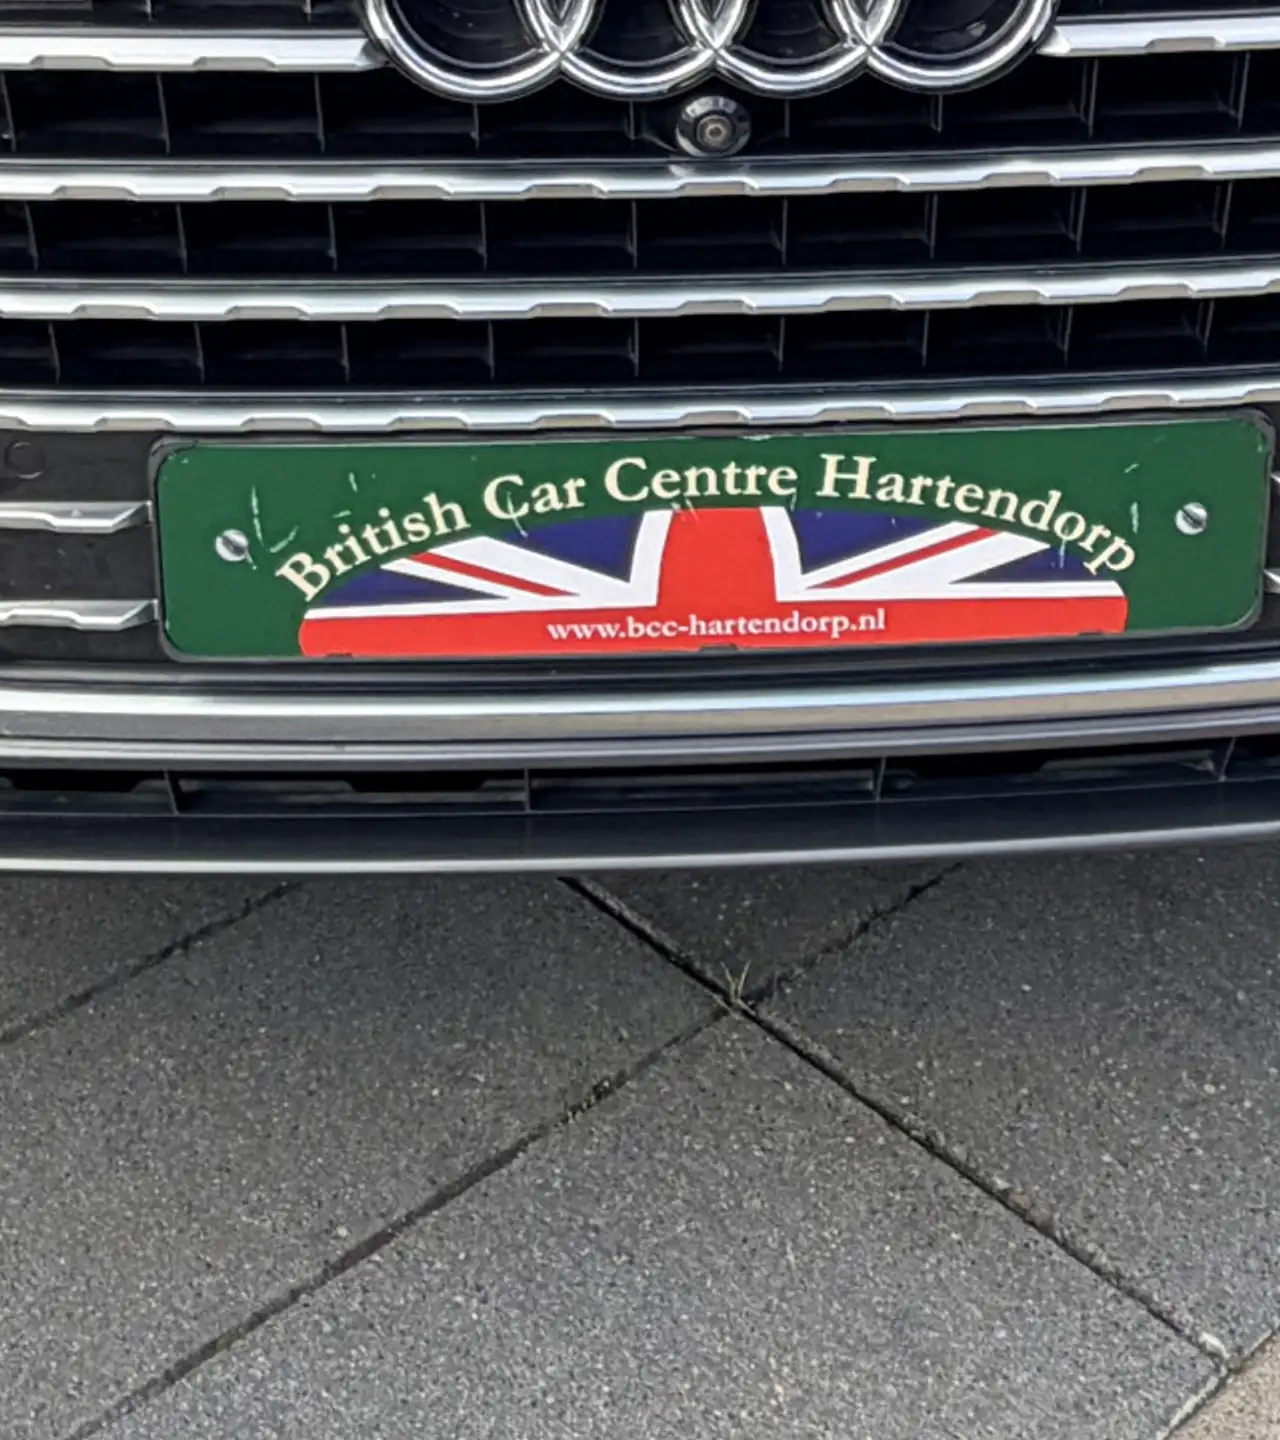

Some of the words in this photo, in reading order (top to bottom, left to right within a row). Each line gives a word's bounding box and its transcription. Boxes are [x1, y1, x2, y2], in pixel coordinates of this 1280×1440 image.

[275, 492, 471, 602] British
[483, 475, 586, 520] Car
[604, 457, 798, 502] Centre
[815, 453, 1135, 576] Hartendorp
[547, 608, 886, 640] www.bcc-hartendorp.nl
